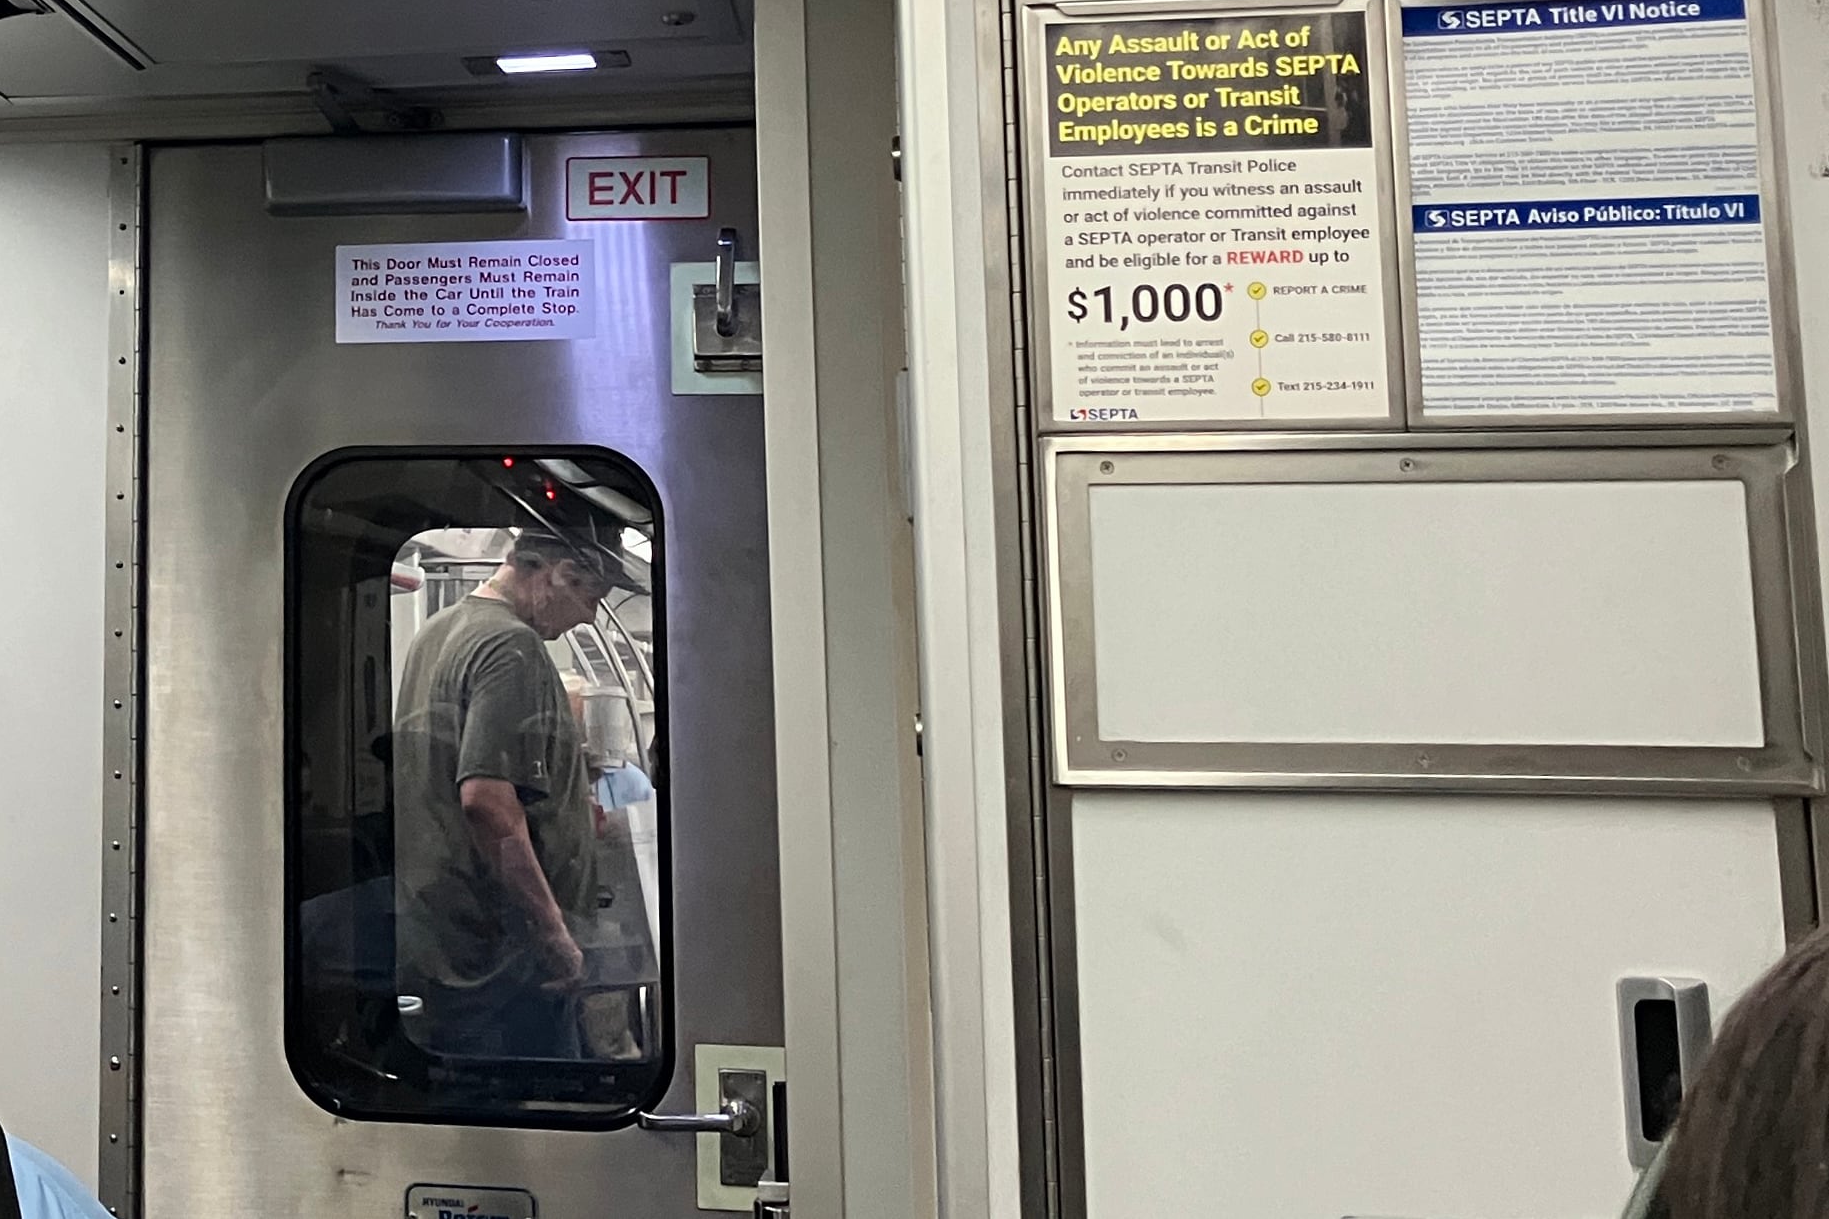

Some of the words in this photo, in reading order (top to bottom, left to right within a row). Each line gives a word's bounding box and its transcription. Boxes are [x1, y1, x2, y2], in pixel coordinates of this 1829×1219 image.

[1465, 7, 1541, 28] SEPTA
[1549, 5, 1597, 24] Title
[1601, 5, 1624, 21] VI
[1630, 1, 1700, 19] Notice
[1055, 37, 1103, 59] Any
[1107, 30, 1200, 54] Assault
[1204, 34, 1232, 50] or
[1236, 29, 1280, 49] Act
[1284, 26, 1311, 47] of
[1055, 62, 1161, 84] Violence
[1166, 57, 1269, 80] Towards
[1275, 54, 1360, 76] SEPTA
[1057, 92, 1177, 117] Operators
[1183, 93, 1210, 108] or
[1214, 85, 1301, 107] Transit
[1058, 119, 1190, 145] Employees
[1195, 117, 1218, 137] is
[1222, 121, 1239, 136] a
[1243, 114, 1319, 135] Crime
[1061, 165, 1125, 178] Contact
[1128, 163, 1184, 176] SEPTA
[1186, 161, 1243, 174] Transit
[1246, 159, 1298, 172] Police
[588, 171, 687, 206] EXIT
[1062, 185, 1161, 202] immediately
[1164, 184, 1176, 197] if
[1179, 187, 1209, 201] you
[1212, 184, 1276, 196] witness
[1279, 184, 1300, 194] an
[1303, 179, 1363, 194] assault
[1063, 213, 1080, 223] or
[1083, 211, 1110, 222] act
[1112, 208, 1130, 221] of
[1132, 208, 1201, 221] violence
[1204, 204, 1293, 219] committed
[1296, 204, 1357, 220] against
[1451, 209, 1520, 227] SEPTA
[1527, 207, 1579, 224] Aviso
[1584, 204, 1661, 223] Público:
[1663, 202, 1720, 220] Título
[1723, 202, 1744, 218] VI
[1064, 236, 1074, 245] a
[1077, 232, 1133, 245] SEPTA
[1136, 231, 1206, 246] operator
[1209, 232, 1227, 242] or
[1230, 228, 1287, 241] Transit
[1291, 227, 1370, 243] employee
[351, 259, 381, 271] This
[386, 258, 422, 270] Door
[427, 257, 462, 269] Must
[468, 257, 522, 267] Remain
[527, 255, 579, 266] Closed
[1065, 255, 1095, 268] and
[1098, 254, 1119, 267] be
[1122, 253, 1181, 270] eligible
[1185, 252, 1209, 265] for
[1212, 255, 1222, 265] a
[1226, 250, 1304, 264] REWARD
[1308, 253, 1330, 266] up
[1333, 250, 1350, 262] to
[350, 275, 379, 286] and
[384, 274, 473, 286] Passengers
[479, 272, 516, 283] Must
[523, 271, 580, 282] Remain
[350, 290, 397, 301] Inside
[403, 290, 429, 300] the
[435, 289, 463, 300] Car
[469, 288, 504, 299] Until
[511, 288, 536, 298] the
[542, 287, 580, 297] Train
[1273, 286, 1317, 295] REPORT
[1321, 285, 1329, 294] A
[1332, 285, 1367, 294] CRIME
[350, 306, 378, 317] Has
[383, 305, 425, 316] Come
[430, 305, 446, 315] to
[451, 307, 461, 315] a
[466, 304, 535, 316] Complete
[541, 302, 580, 315] Stop.
[1274, 334, 1294, 342] Call
[1278, 382, 1300, 391] Text
[1088, 409, 1138, 420] SEPTA
